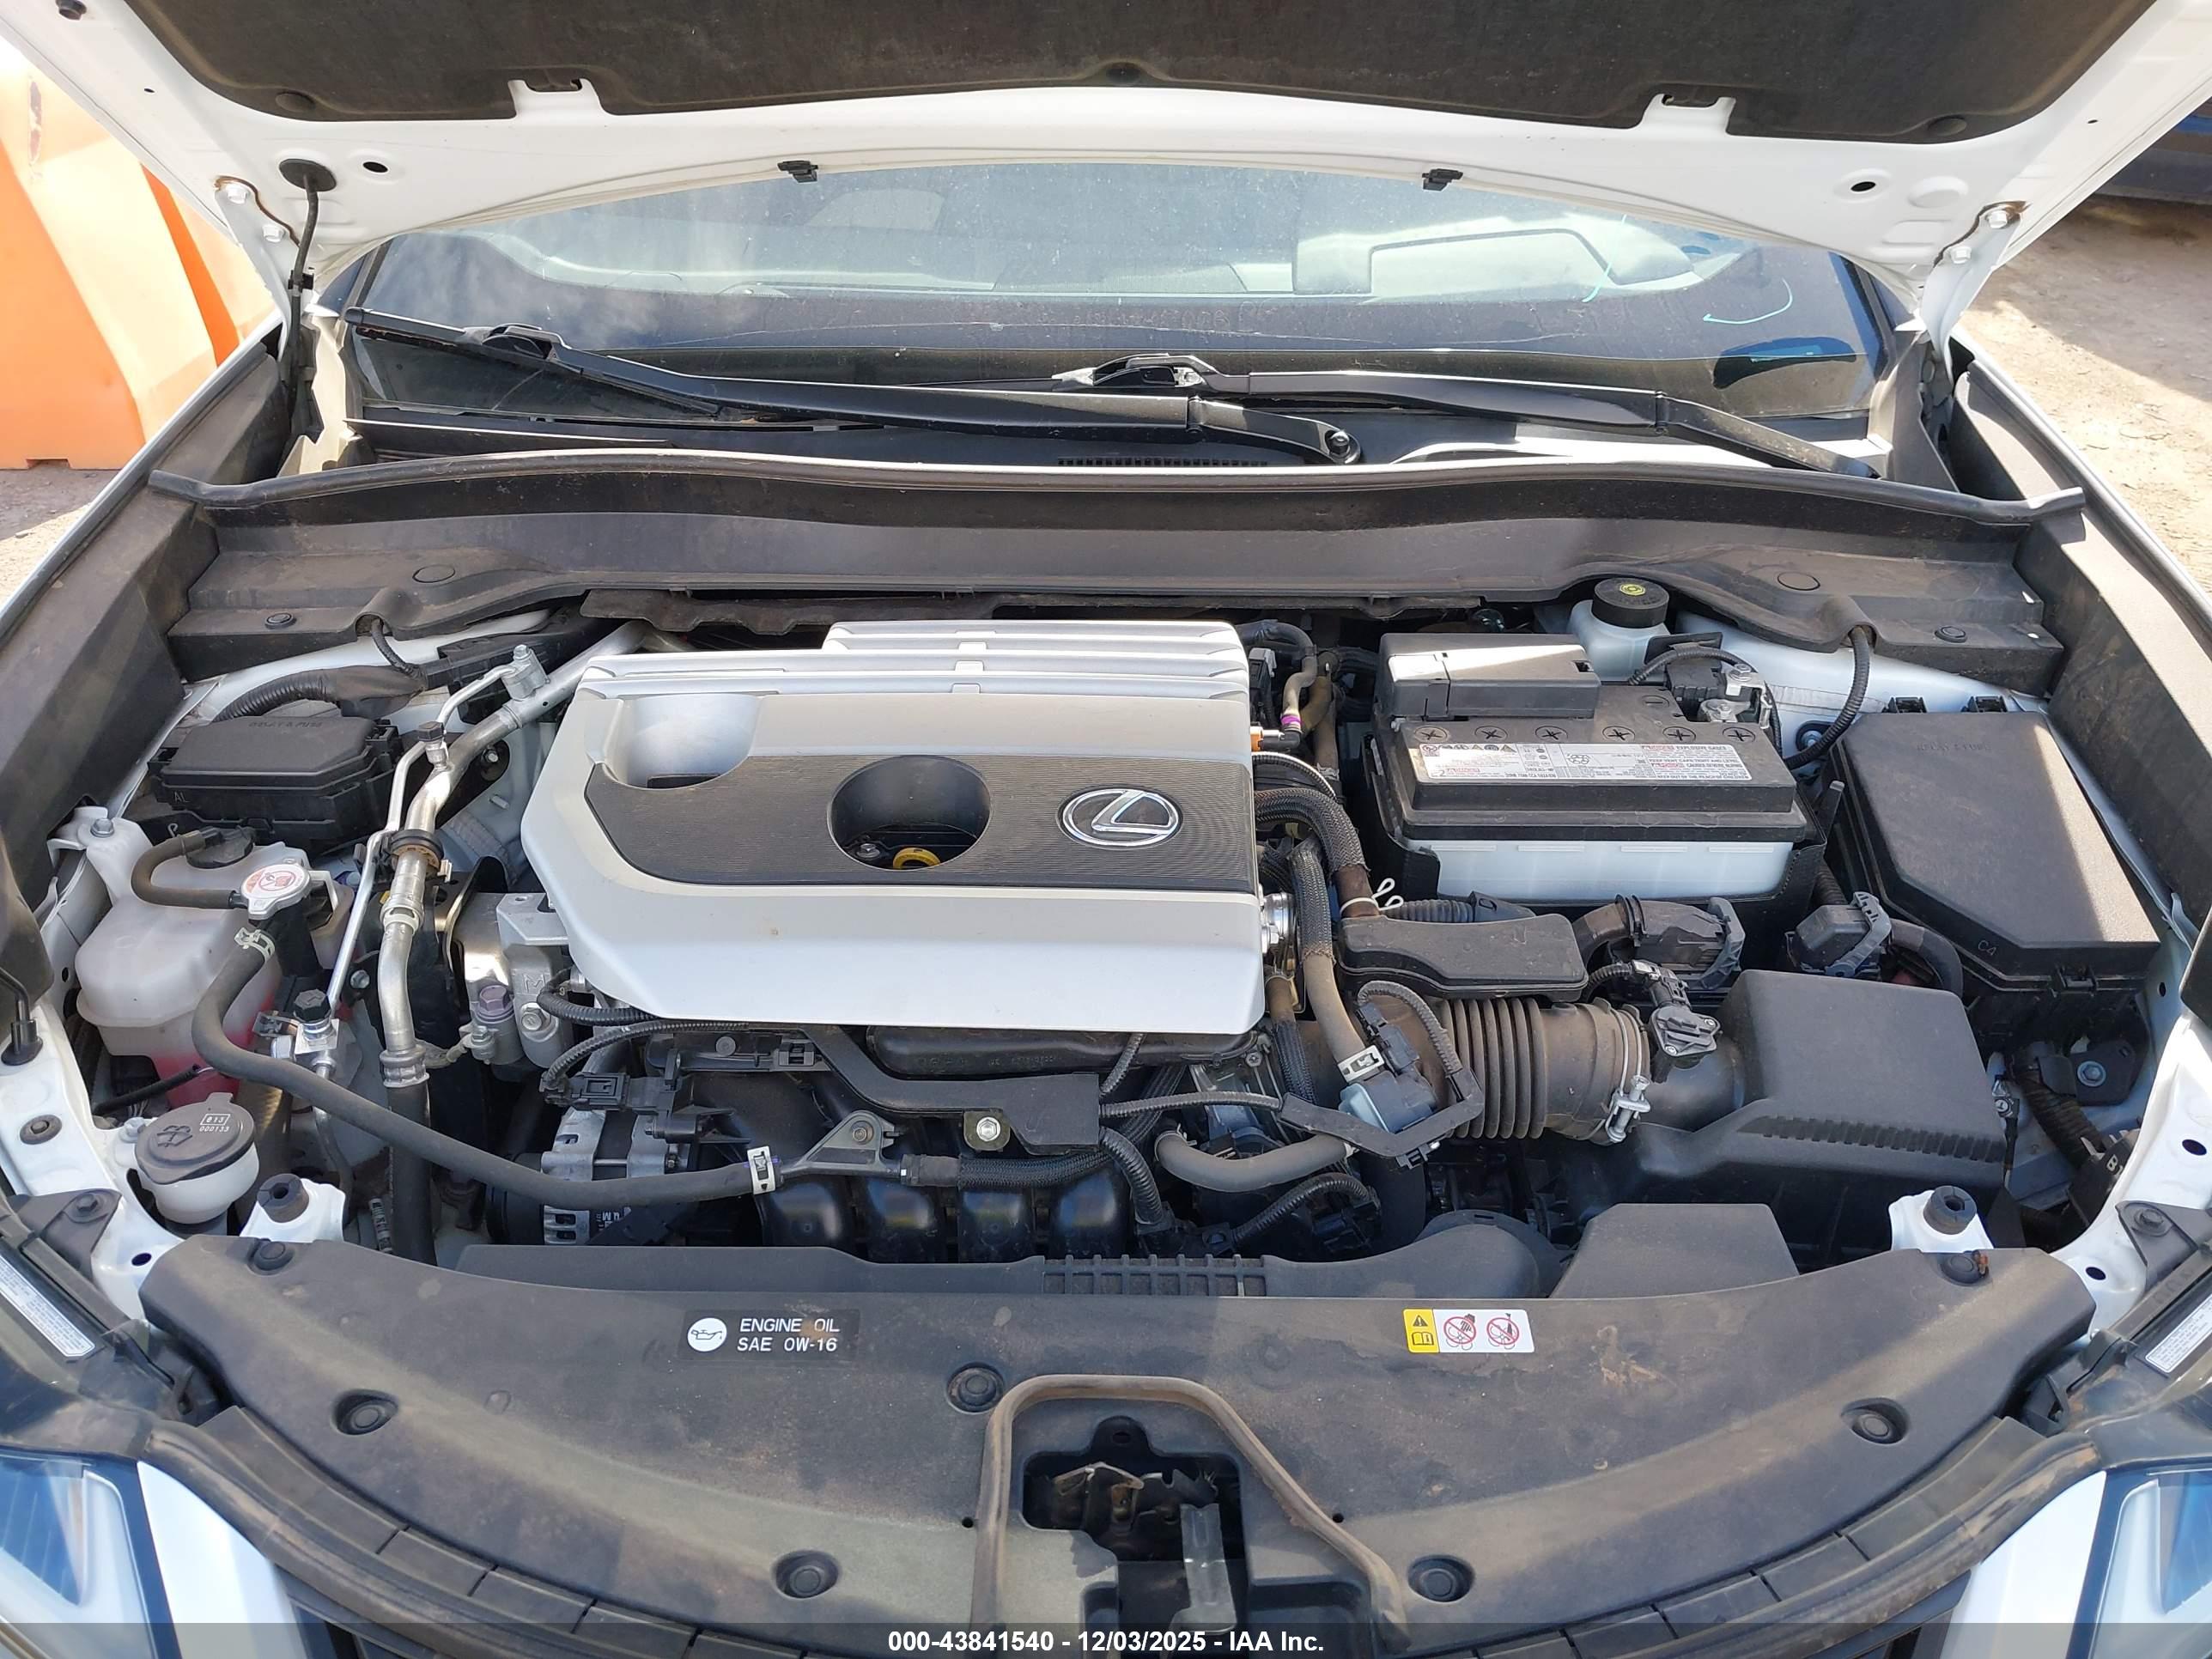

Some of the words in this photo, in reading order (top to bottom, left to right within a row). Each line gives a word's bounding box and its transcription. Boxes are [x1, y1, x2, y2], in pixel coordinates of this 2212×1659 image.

[739, 1318, 802, 1332] ENGINE
[814, 1318, 841, 1332] OIL
[737, 1337, 773, 1352] SAE
[784, 1337, 838, 1352] 0W-16
